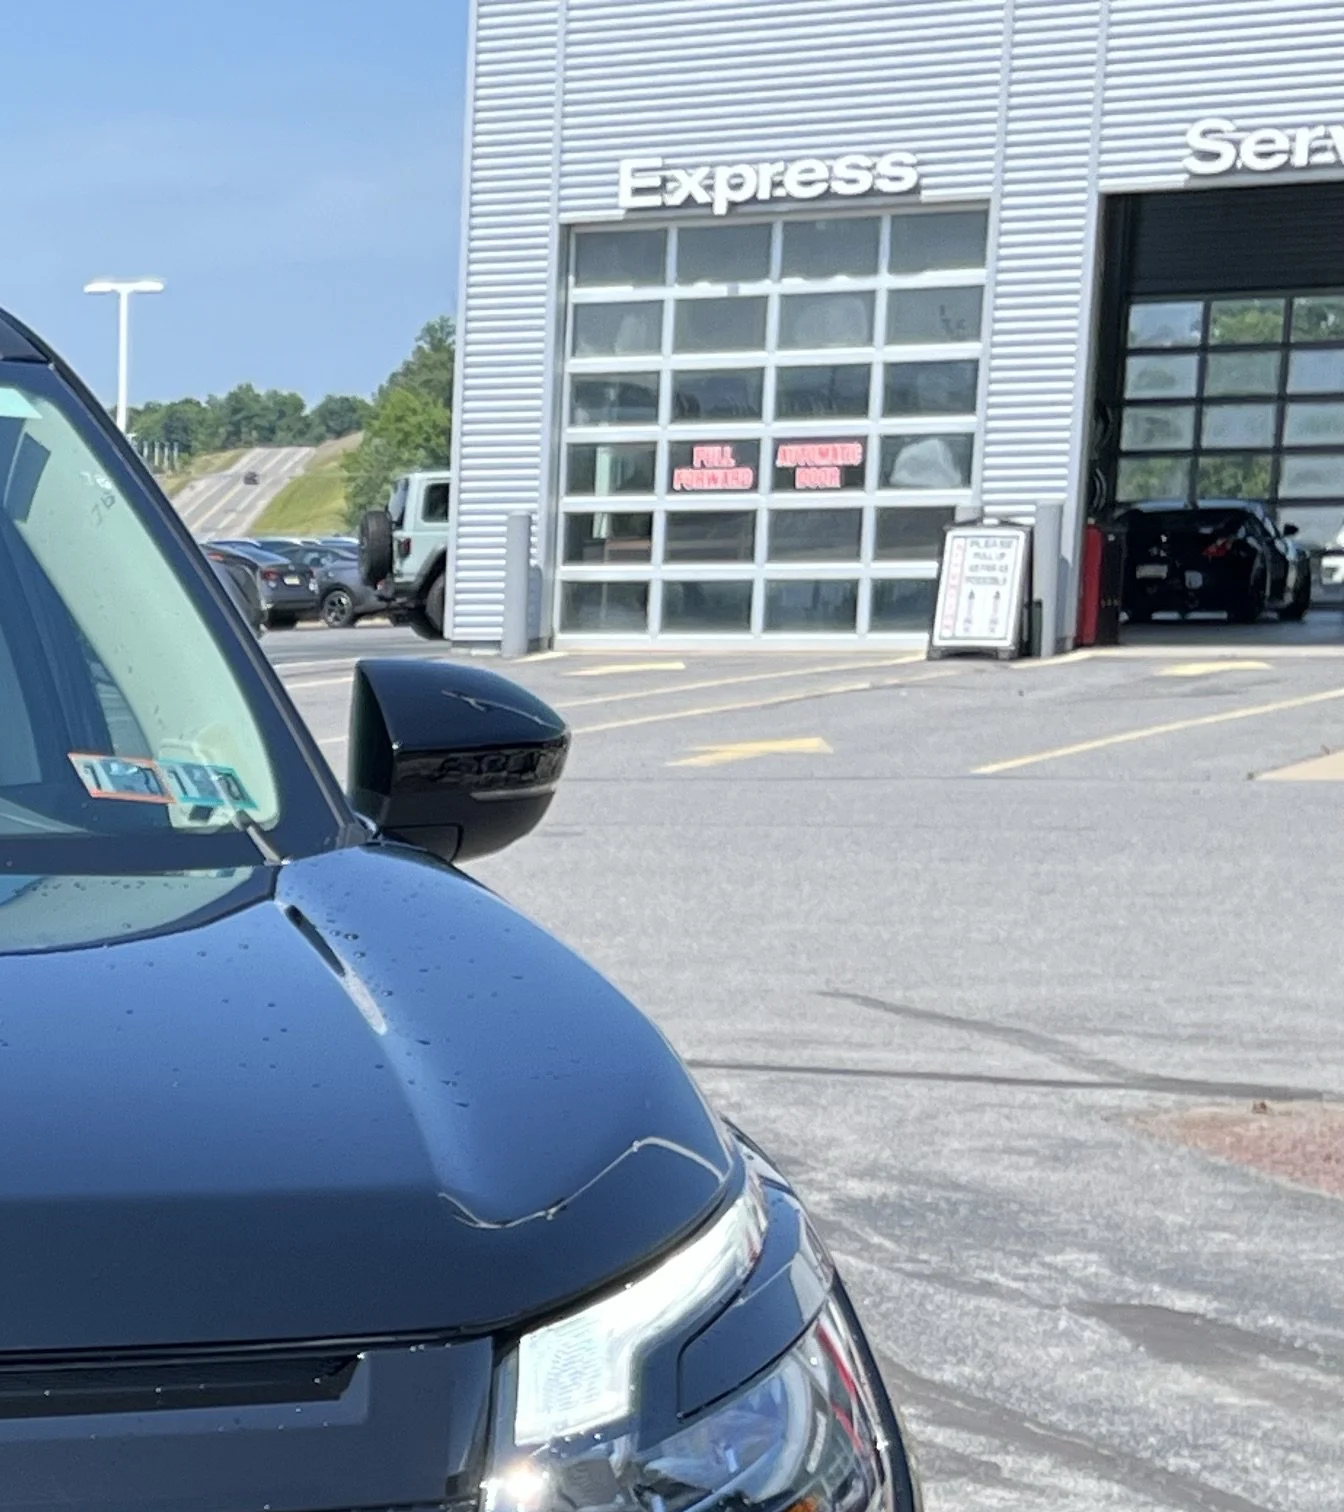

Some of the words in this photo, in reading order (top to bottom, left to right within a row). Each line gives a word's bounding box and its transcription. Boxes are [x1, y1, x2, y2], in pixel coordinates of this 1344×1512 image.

[618, 152, 918, 215] Express
[693, 445, 736, 467] PULL
[776, 442, 862, 467] AUTOMATIC
[673, 467, 753, 490] FORWARD
